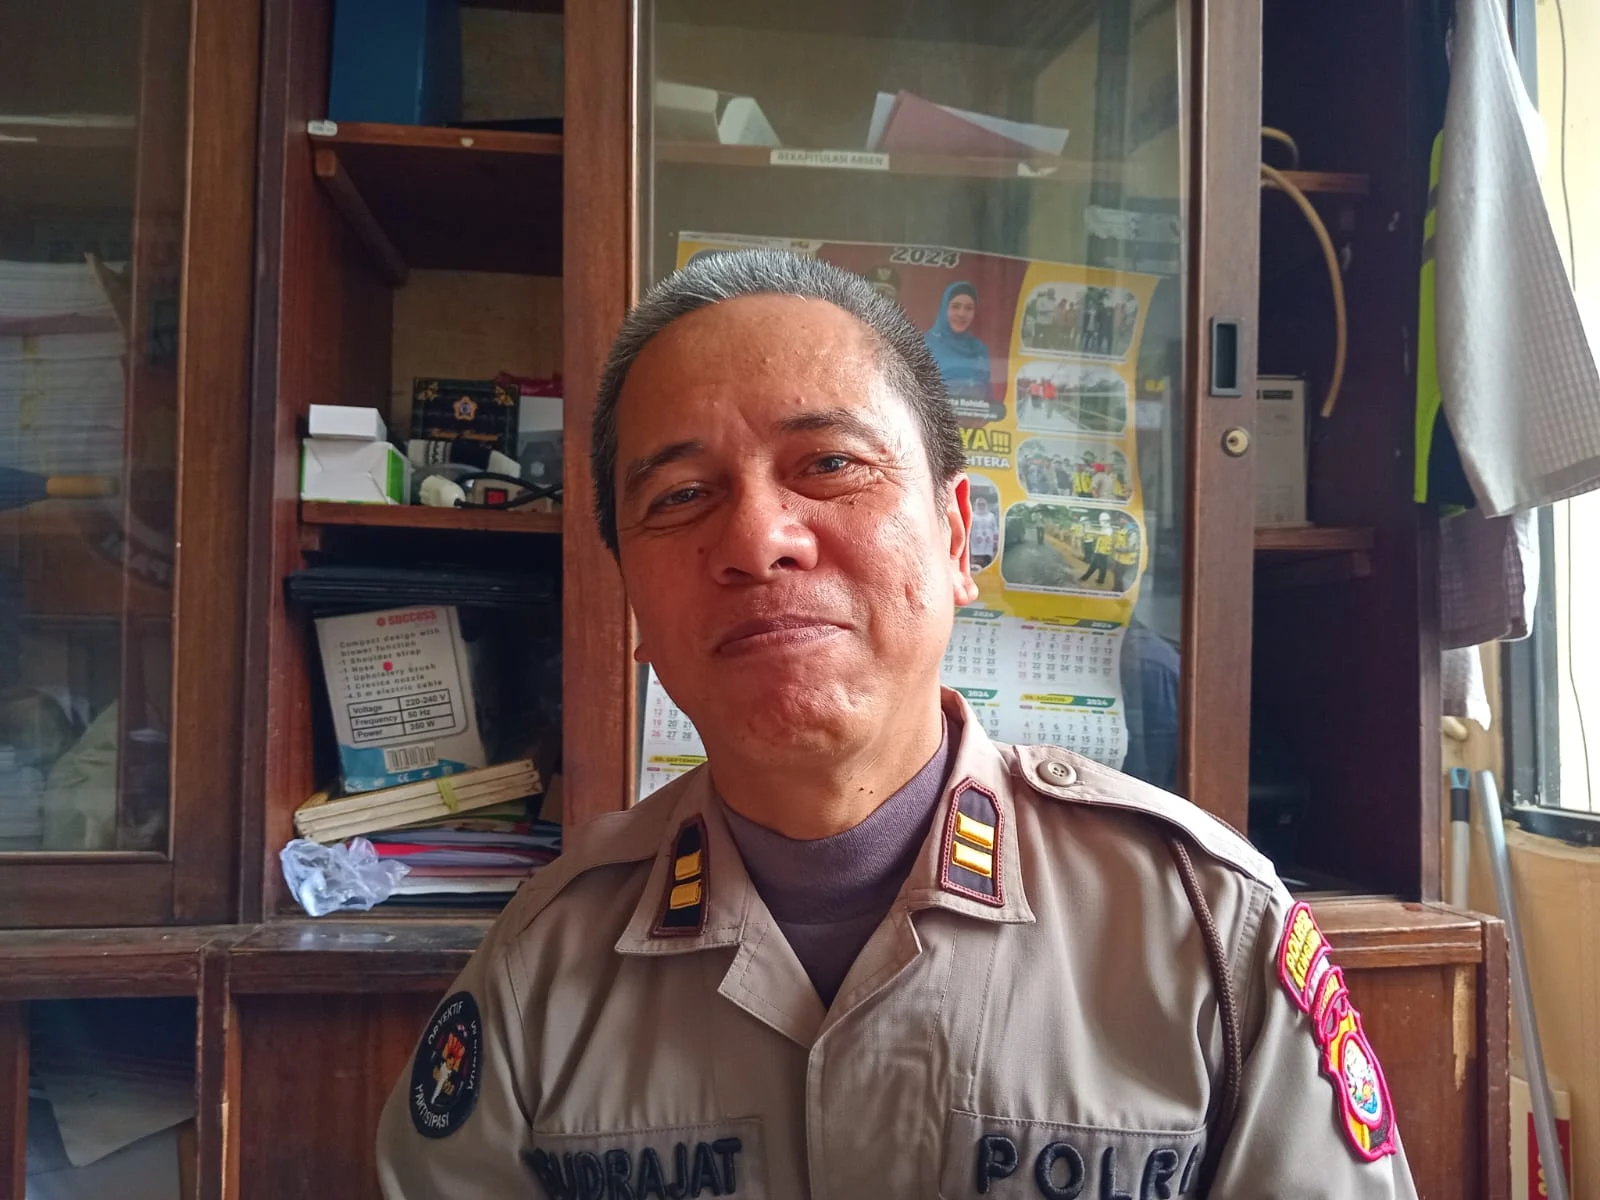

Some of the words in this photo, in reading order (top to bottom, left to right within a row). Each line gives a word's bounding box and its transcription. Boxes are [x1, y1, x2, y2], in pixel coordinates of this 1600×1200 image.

[890, 246, 960, 268] 2024
[352, 704, 383, 715] Voltage
[405, 694, 438, 707] 220-240
[439, 693, 446, 701] V
[354, 714, 399, 727] Frequency
[407, 711, 418, 719] 50
[420, 708, 432, 717] Hz
[357, 728, 383, 739] Power
[426, 720, 436, 728] W
[977, 1134, 1201, 1200] POLRI
